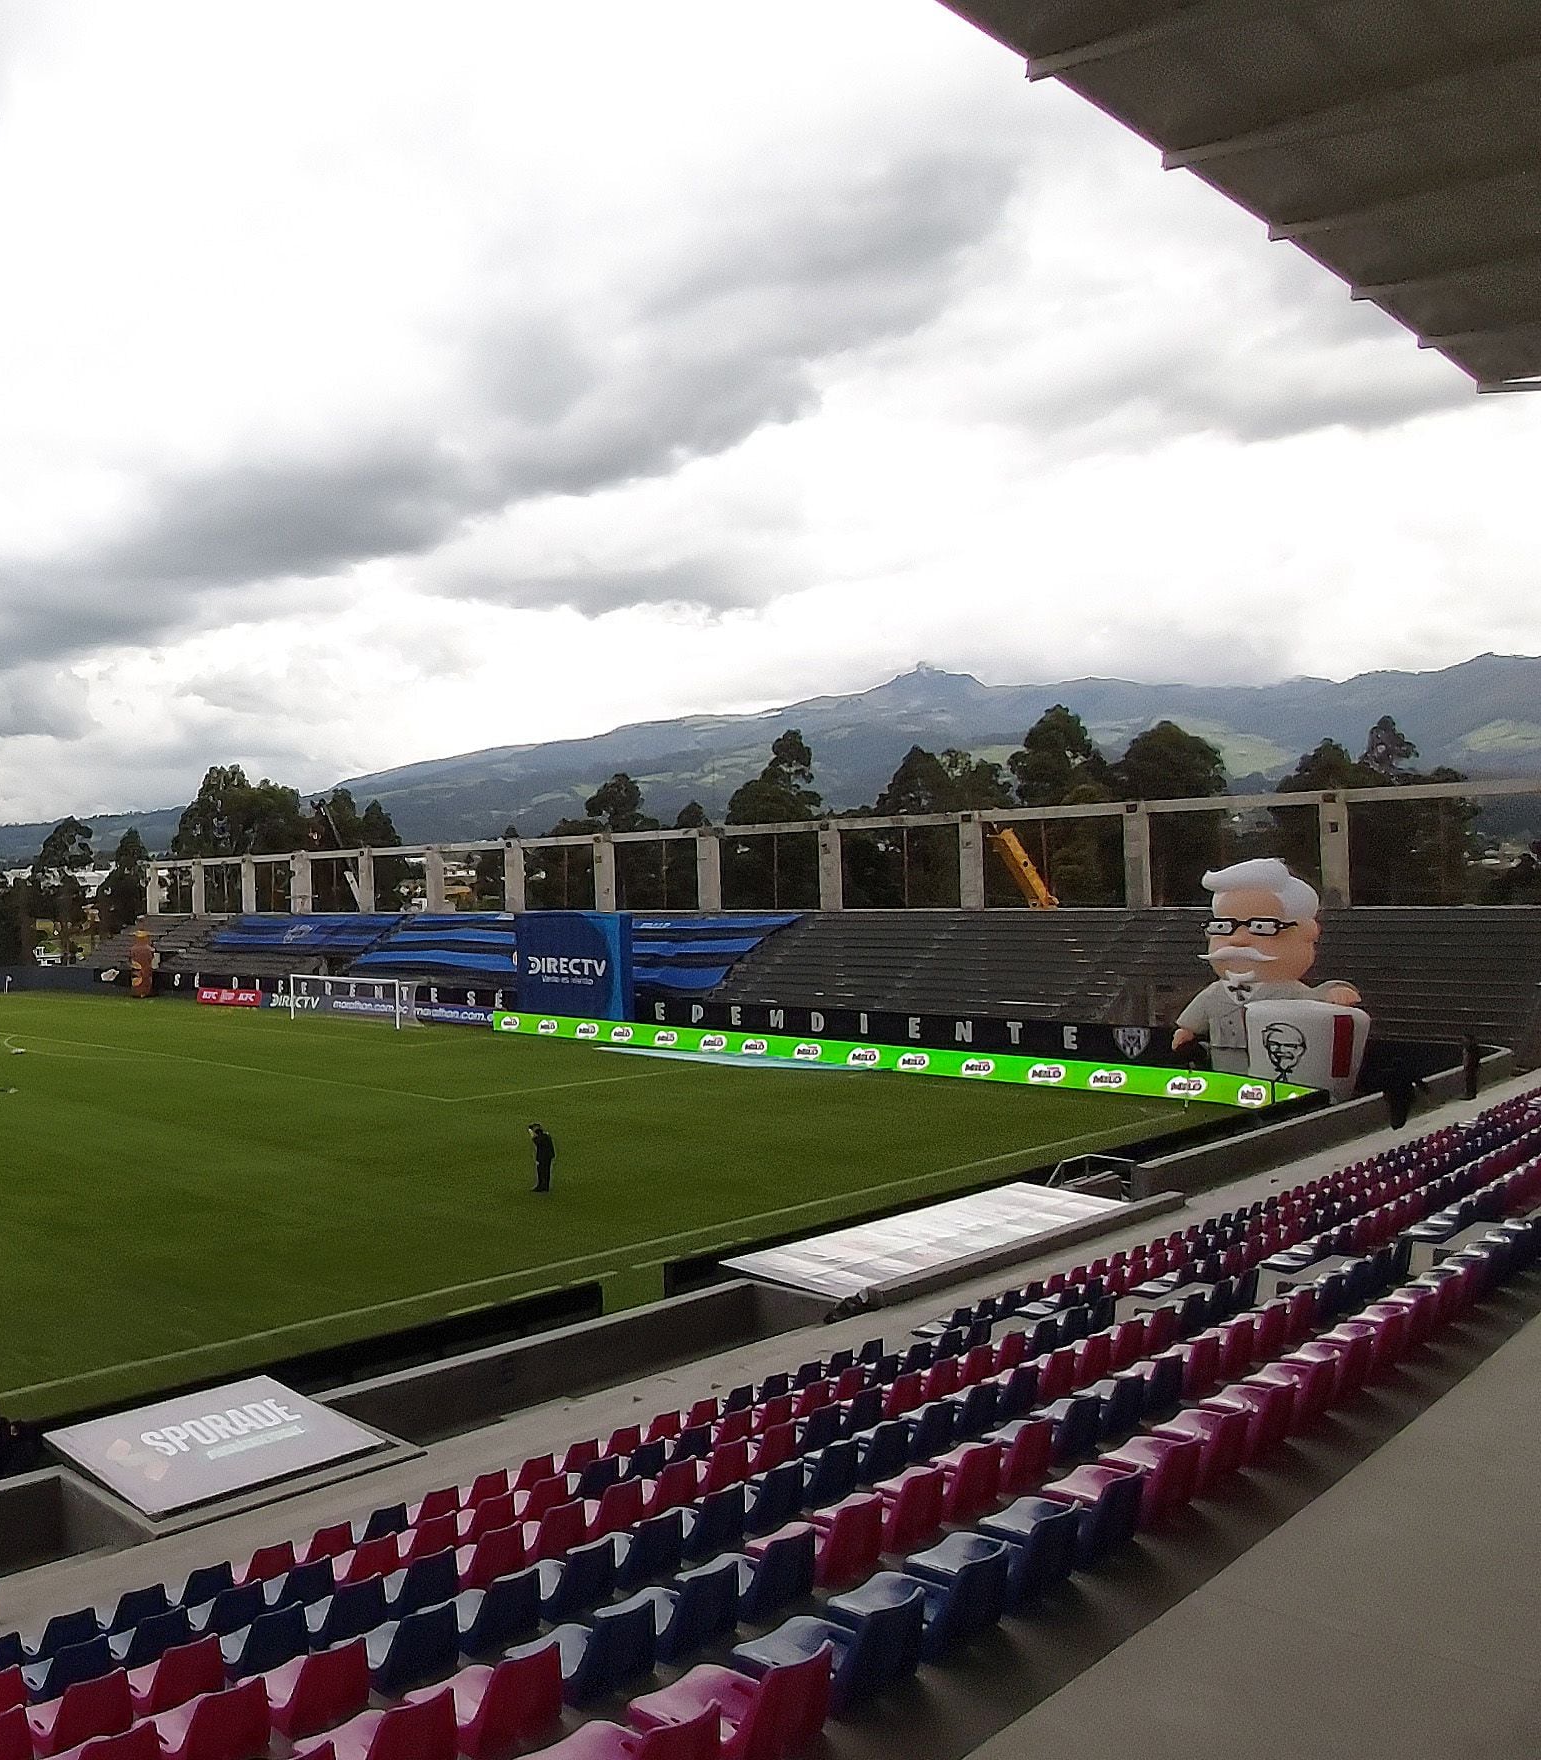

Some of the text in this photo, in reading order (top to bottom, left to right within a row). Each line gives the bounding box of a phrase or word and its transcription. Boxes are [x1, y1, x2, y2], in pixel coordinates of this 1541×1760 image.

[527, 956, 607, 977] DIRECTV
[232, 976, 438, 1003] DIFERENTE
[202, 991, 219, 1000] KFC
[238, 993, 256, 1002] KFC
[269, 992, 320, 1010] DIRECTV
[467, 988, 504, 1009] SÉ
[416, 1006, 494, 1022] marathon.com.e
[655, 1002, 1078, 1050] EPENDIENTE
[852, 1052, 877, 1062] MILO
[902, 1057, 926, 1066] MILO
[965, 1063, 990, 1072] MILO
[1031, 1068, 1061, 1079] MILO
[1093, 1074, 1122, 1085] MILO
[1171, 1081, 1202, 1092] MILO
[1241, 1090, 1263, 1101] MILO
[139, 1398, 303, 1457] SPORADE
